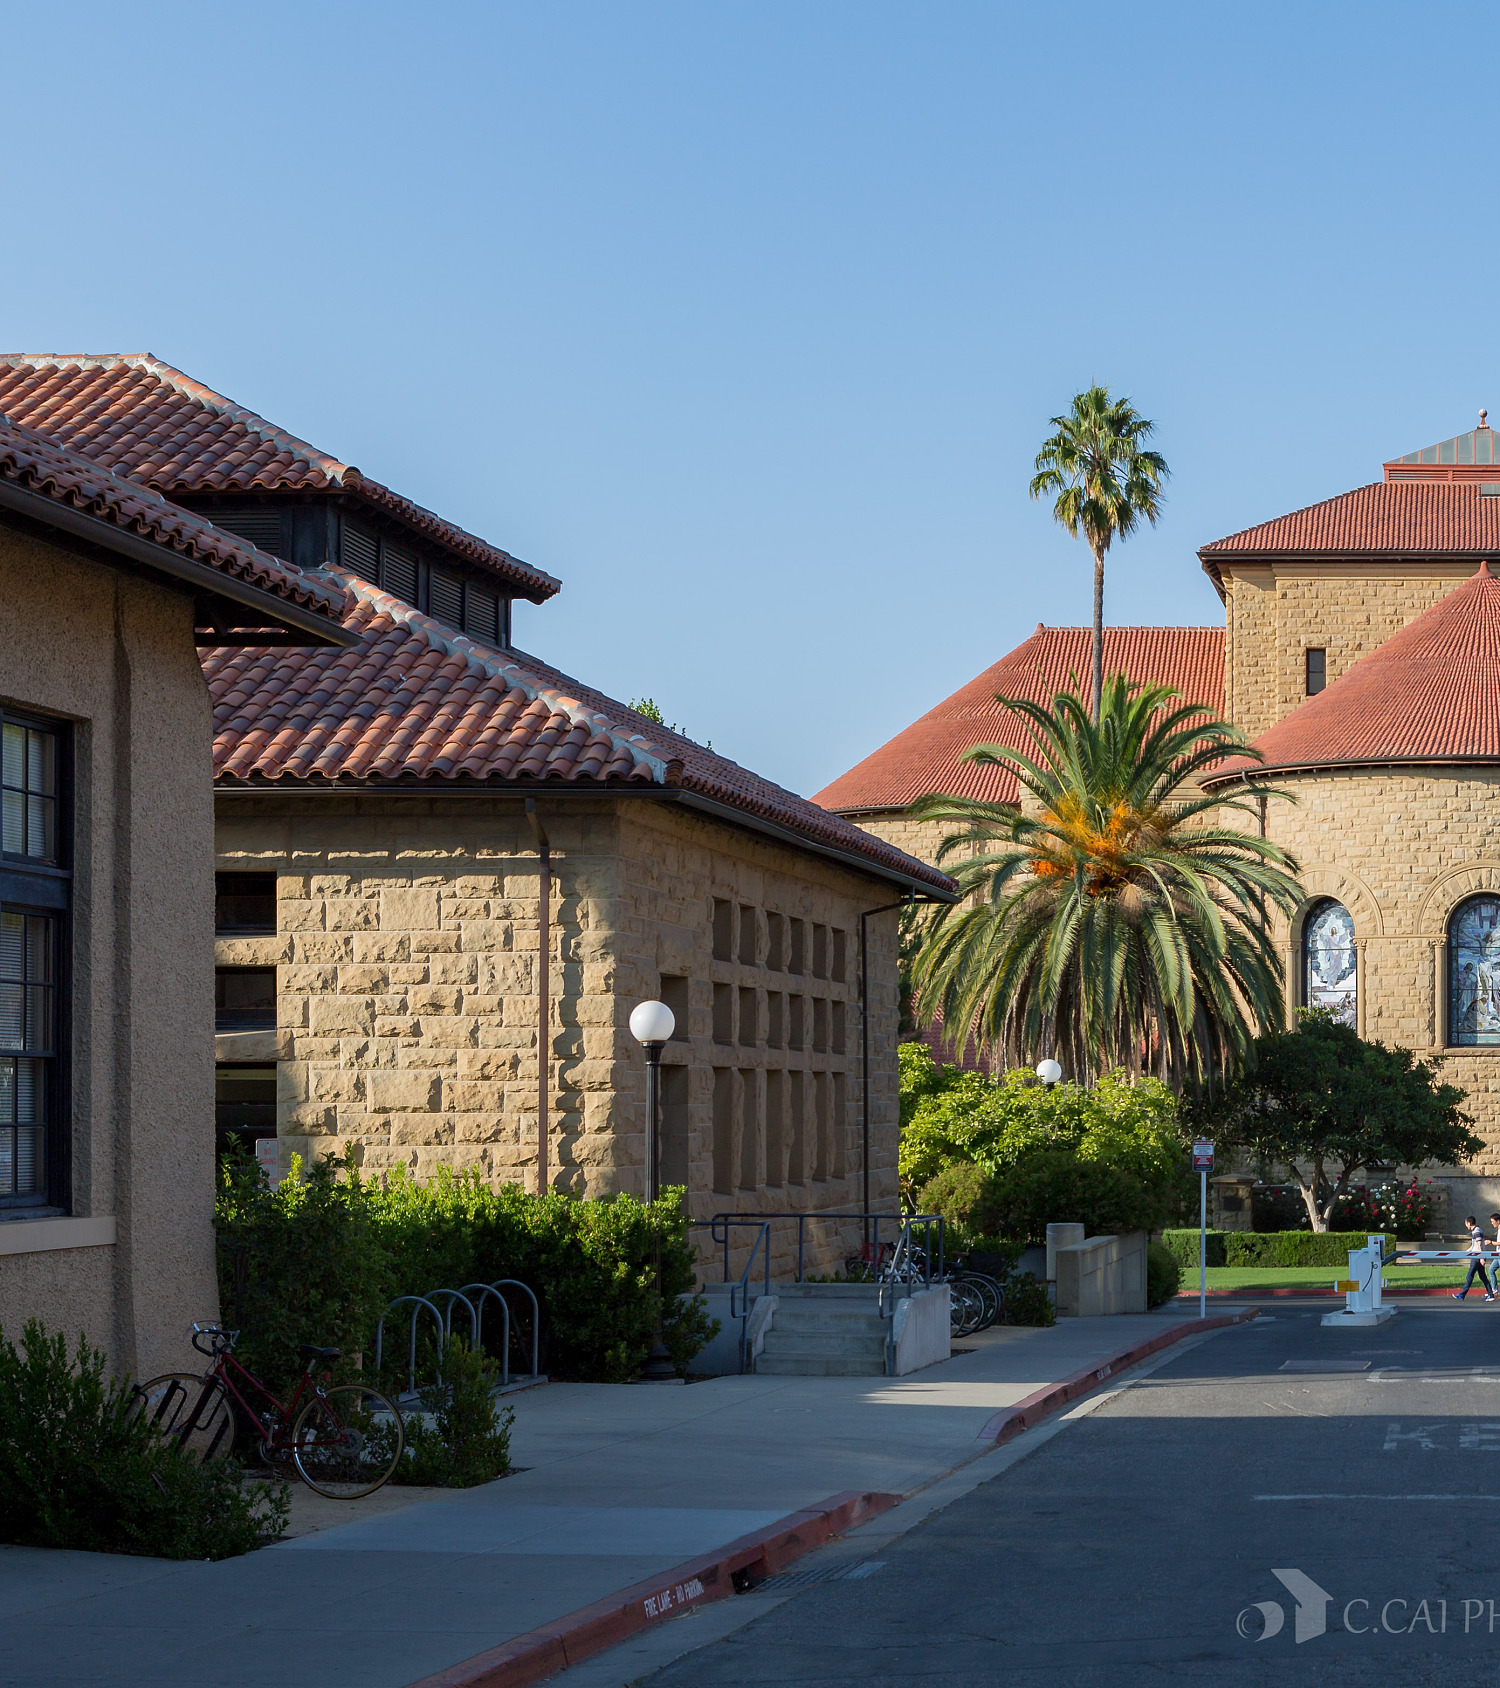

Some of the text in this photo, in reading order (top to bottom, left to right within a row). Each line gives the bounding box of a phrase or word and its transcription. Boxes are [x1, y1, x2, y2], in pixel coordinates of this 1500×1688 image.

[643, 1596, 659, 1619] FIRE
[656, 1590, 673, 1613] LANE
[675, 1585, 685, 1604] NO
[683, 1578, 705, 1601] PARKING
